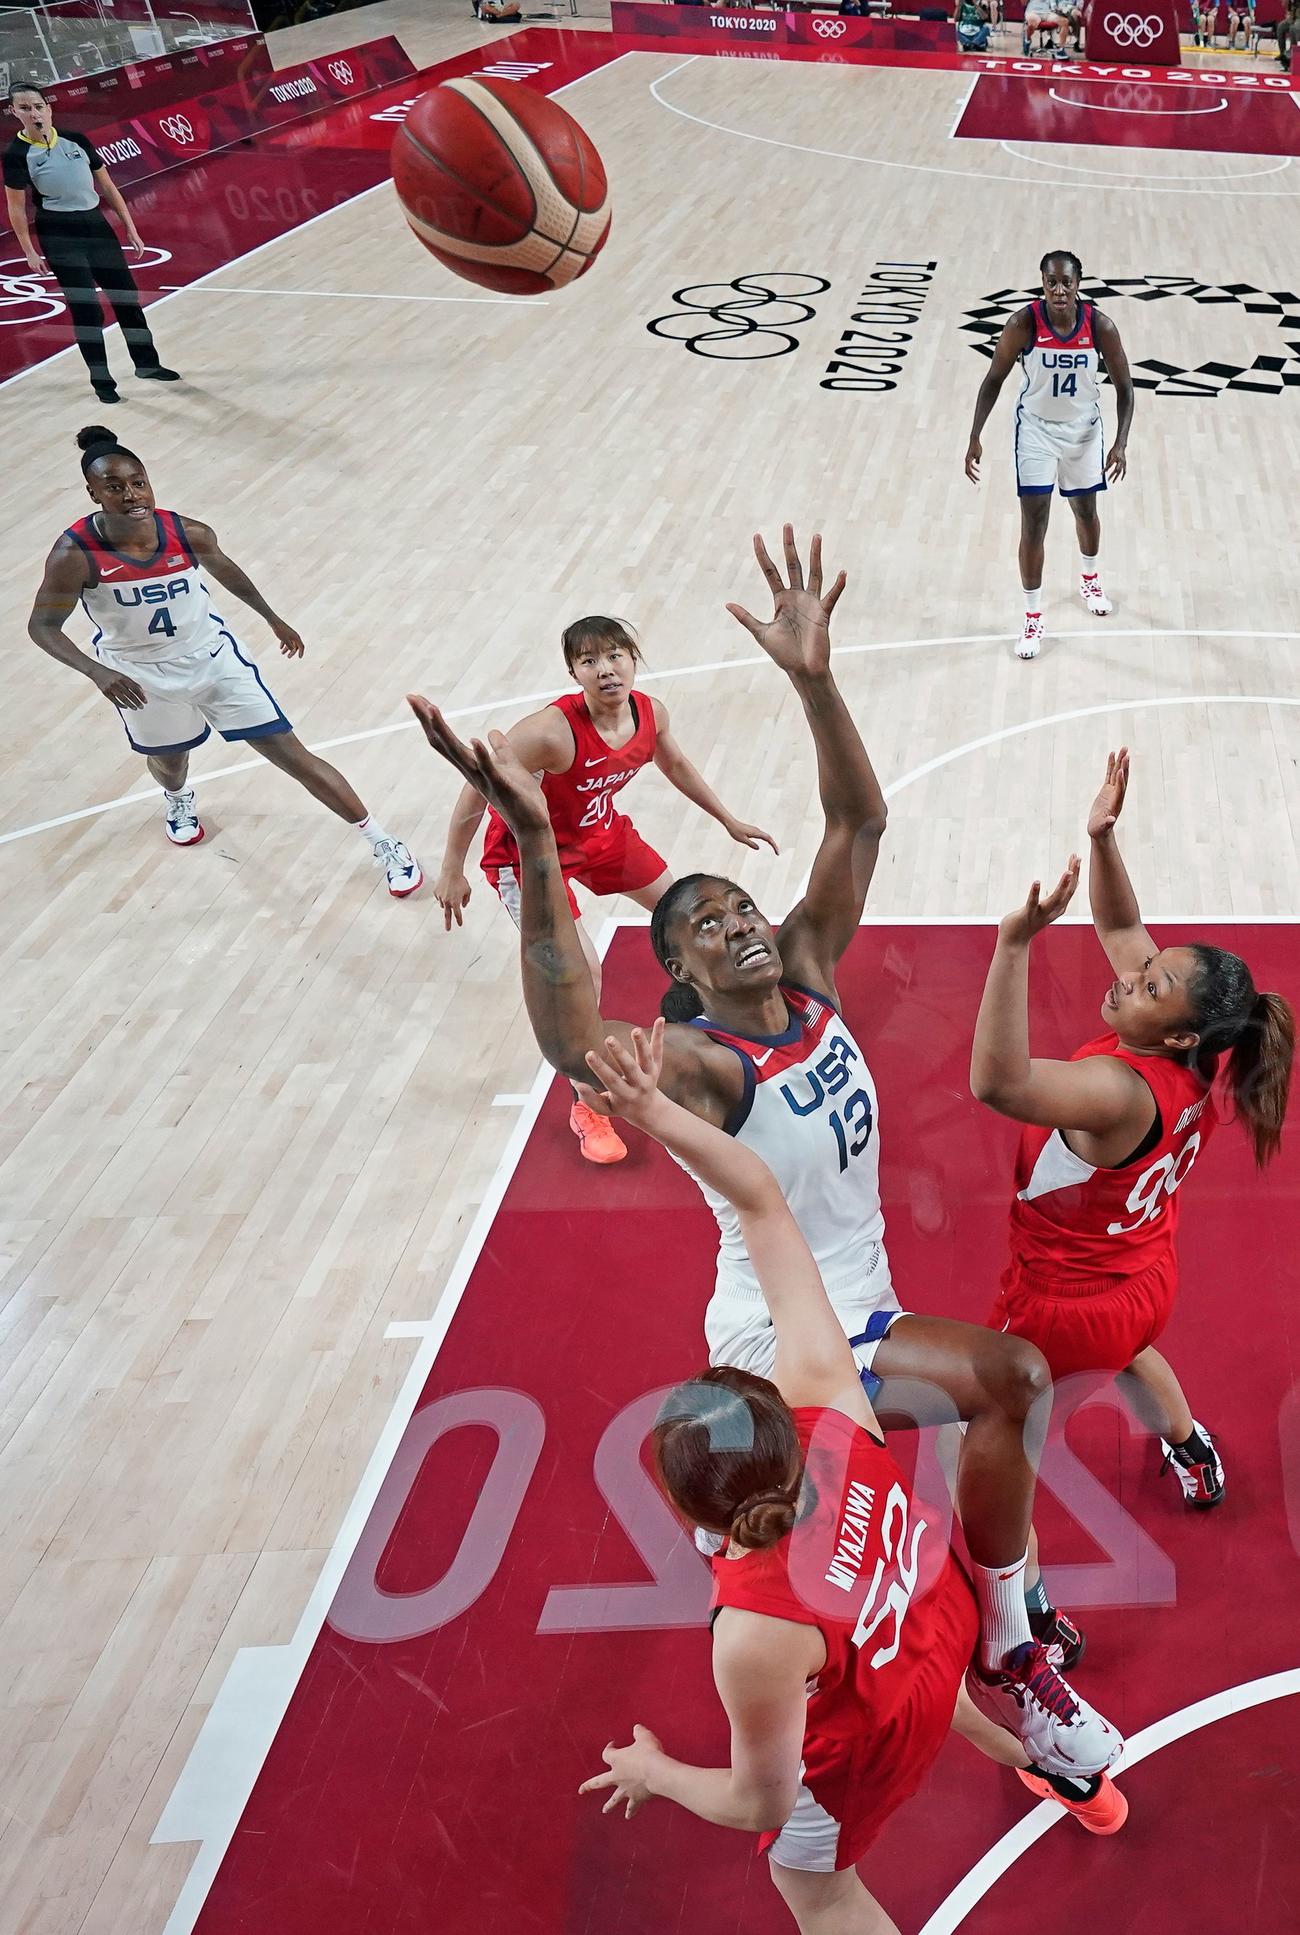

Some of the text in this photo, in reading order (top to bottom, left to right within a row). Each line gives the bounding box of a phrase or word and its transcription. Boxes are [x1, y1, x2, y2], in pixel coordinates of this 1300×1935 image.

[709, 15, 777, 31] TOKYO 2020
[978, 59, 1292, 87] TOKYO 2020
[269, 76, 317, 103] TOKYO 2020
[109, 137, 141, 161] 2020
[819, 261, 938, 392] TOKYO 2020
[1042, 353, 1089, 369] USA
[1053, 373, 1077, 397] 14
[113, 577, 190, 606] USA
[148, 607, 178, 637] 4
[576, 767, 640, 791] JAPAN
[780, 1035, 858, 1117] USA
[829, 1087, 872, 1174] 13
[825, 1480, 876, 1593] MIYAZAWA
[851, 1481, 928, 1670] 52
